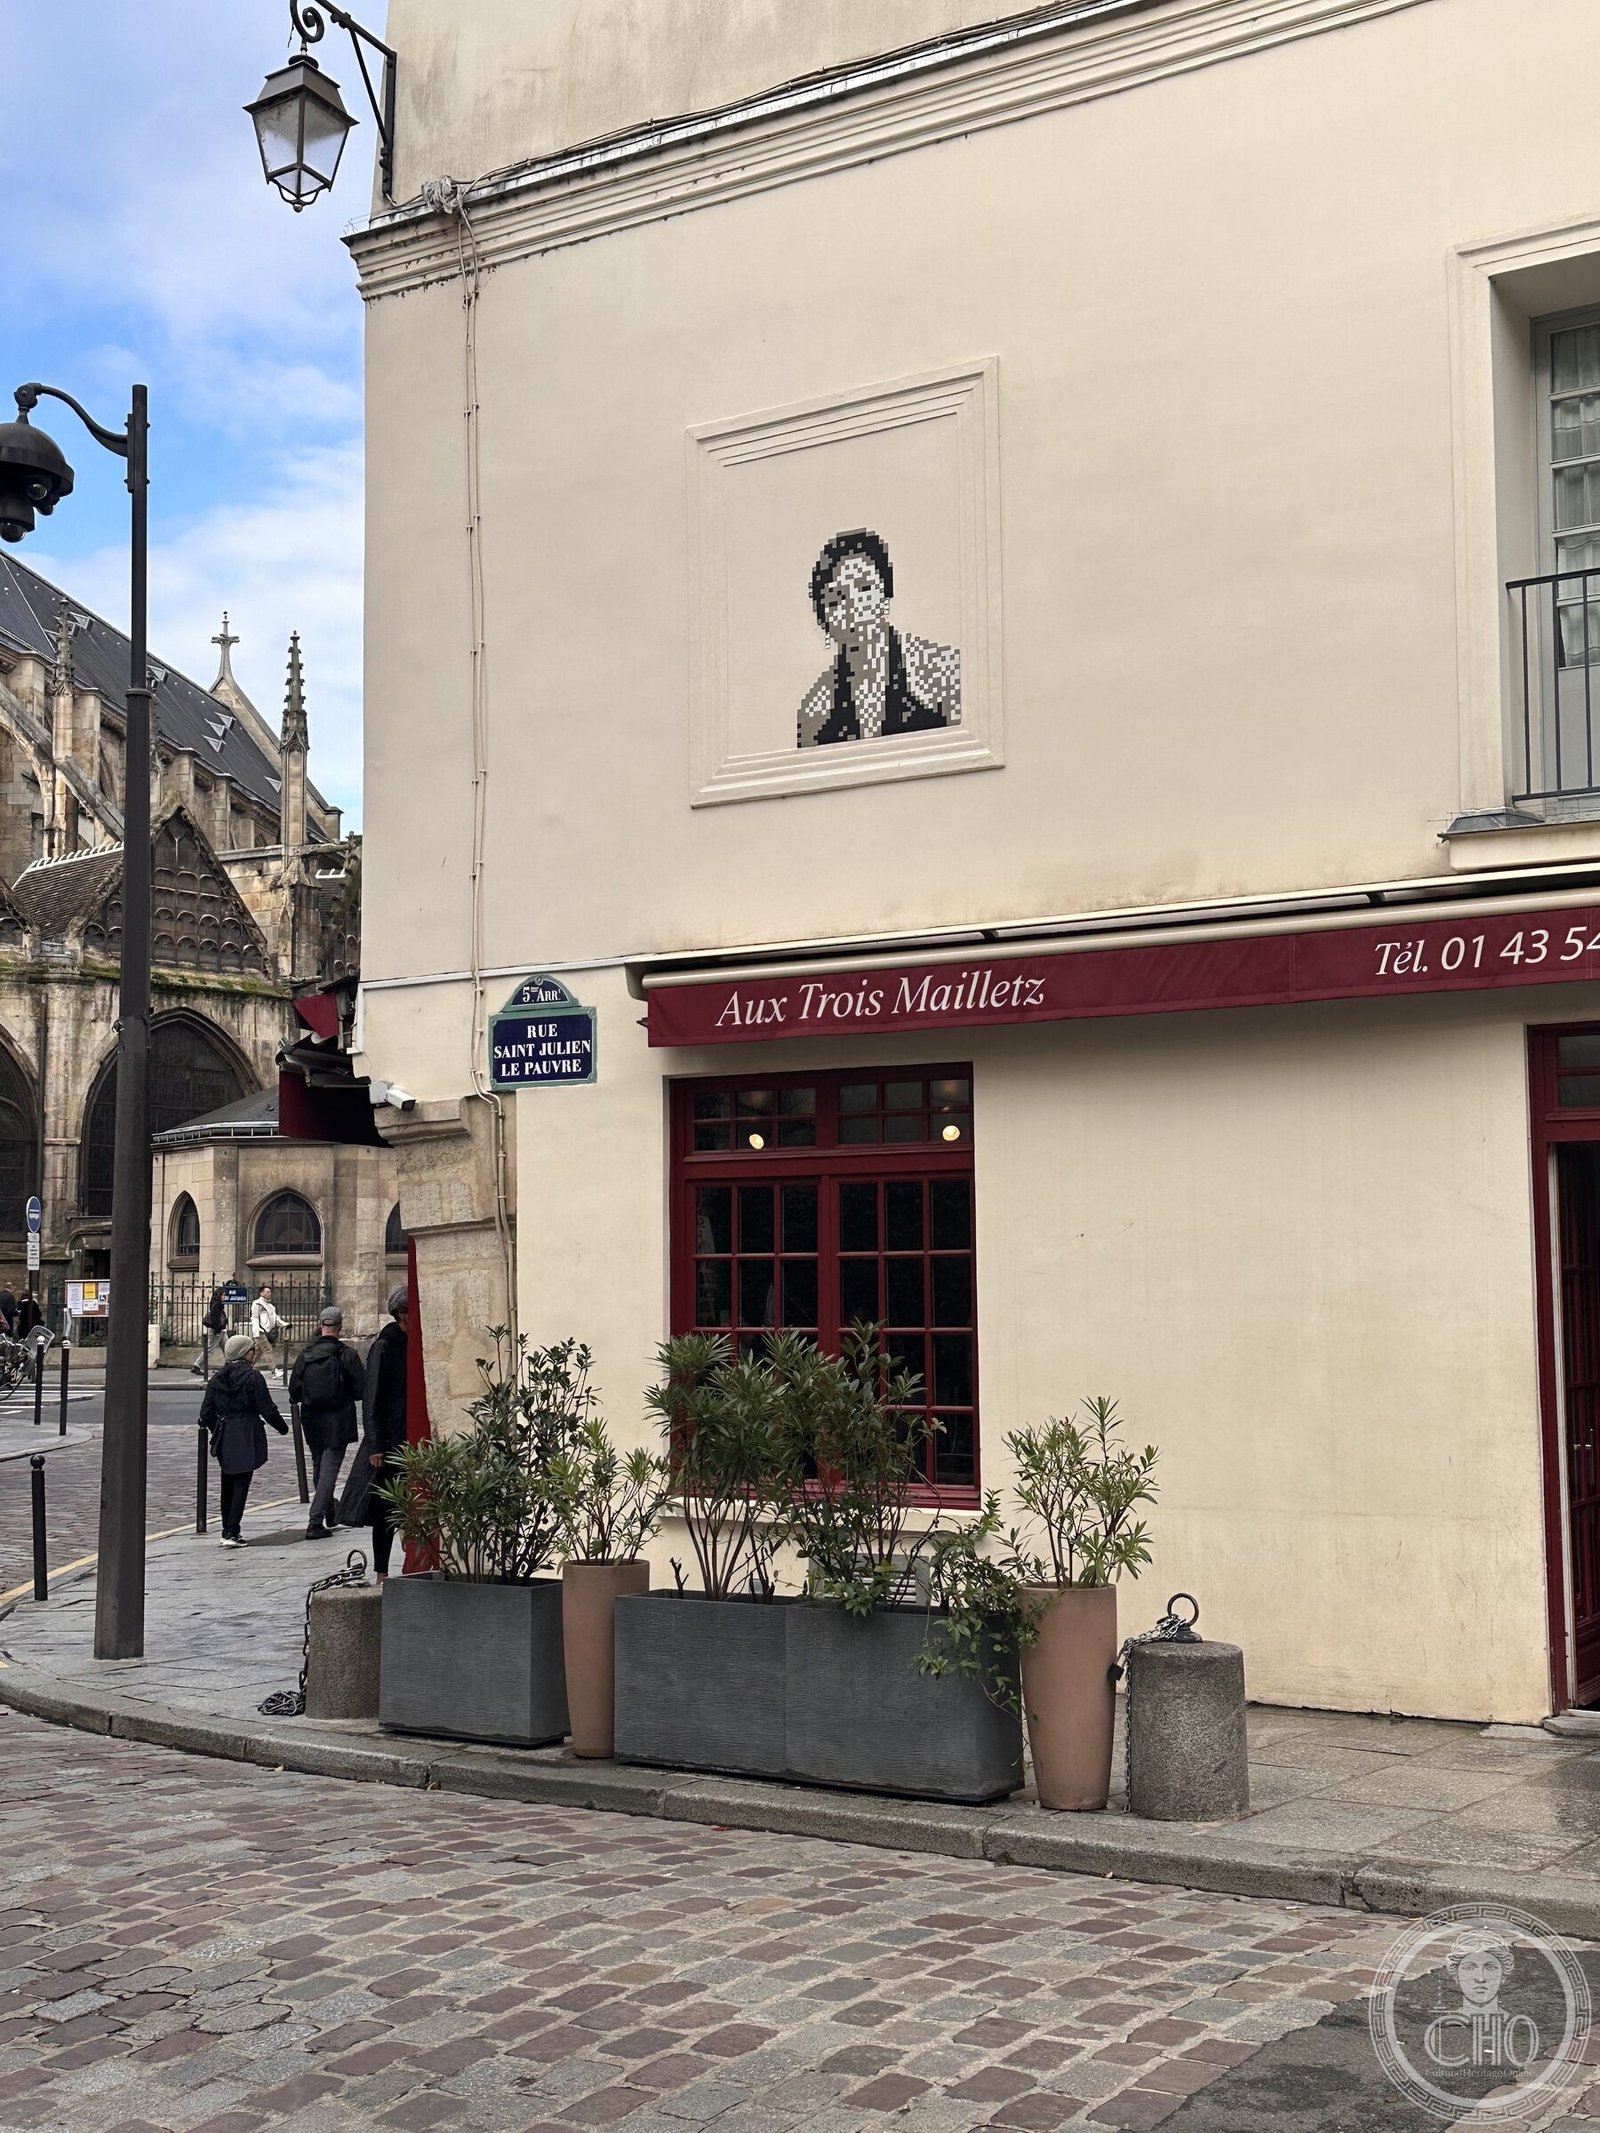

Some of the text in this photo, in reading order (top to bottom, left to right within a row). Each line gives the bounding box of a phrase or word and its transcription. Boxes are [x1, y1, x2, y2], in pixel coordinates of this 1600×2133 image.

[1374, 939, 1429, 976] Tél.
[1441, 934, 1486, 971] 01
[1499, 929, 1550, 965] 43
[715, 970, 1047, 1028] Aux Trois Mailletz
[527, 1023, 558, 1039] RUE
[493, 1039, 591, 1059] SAINT JULIEN
[501, 1058, 582, 1077] LE PAUVRE
